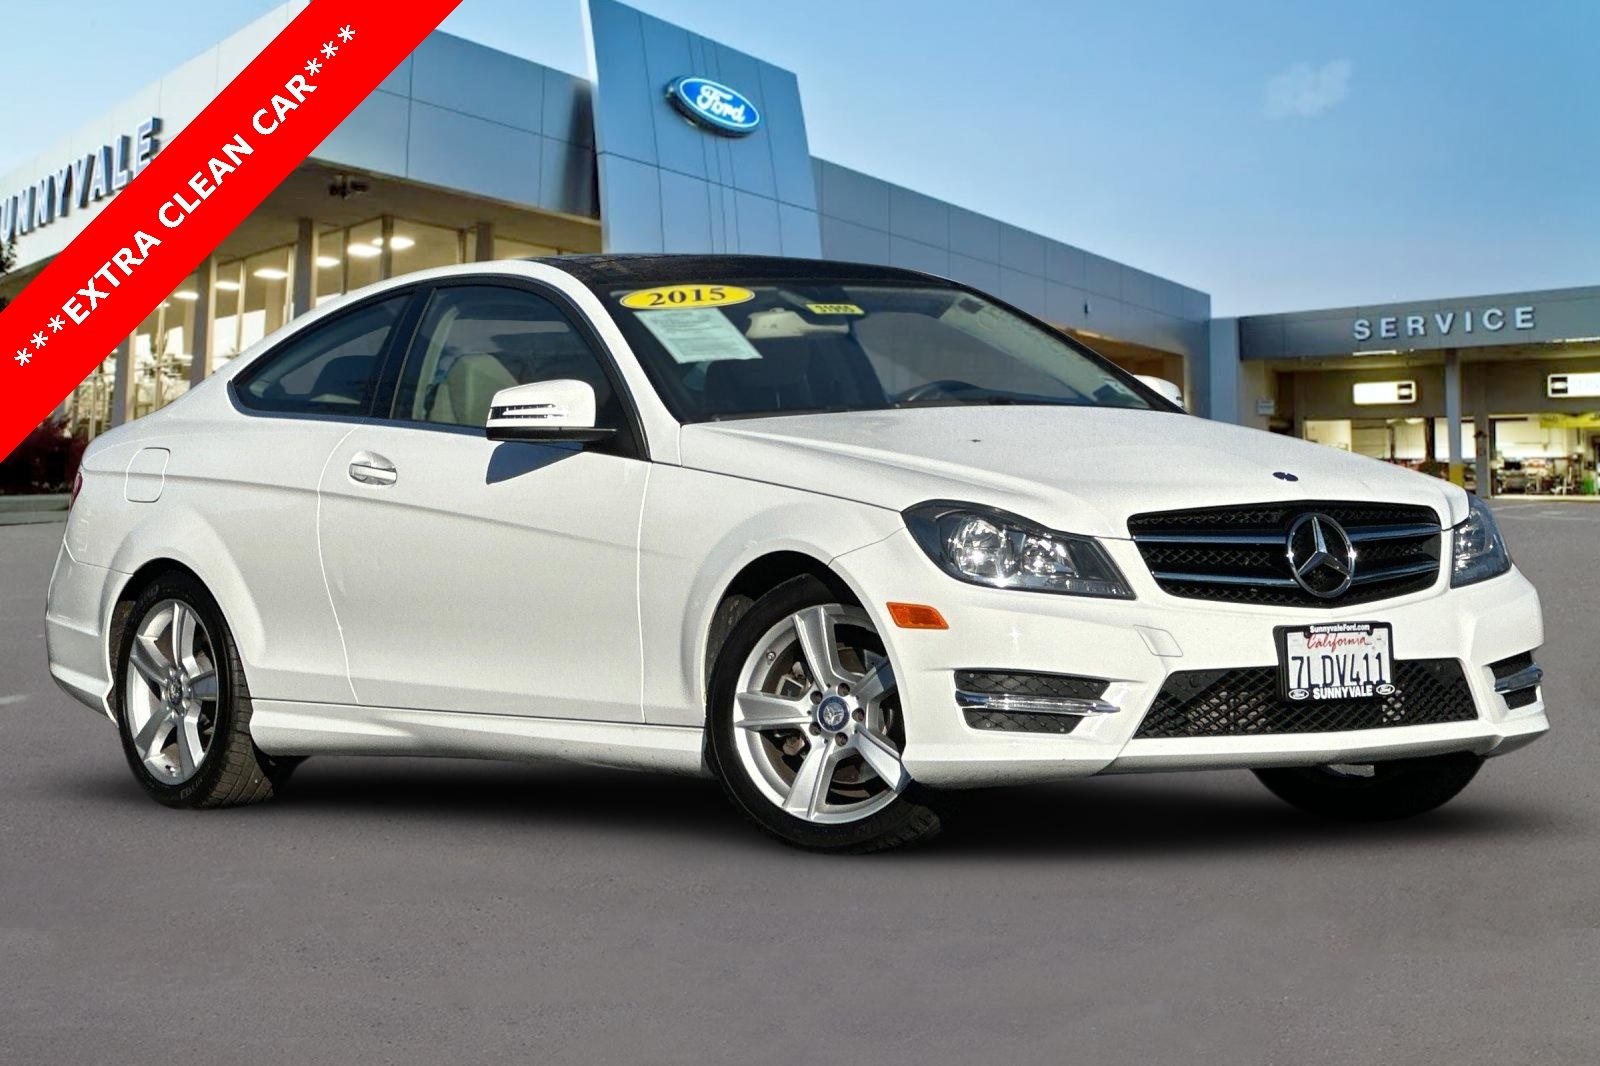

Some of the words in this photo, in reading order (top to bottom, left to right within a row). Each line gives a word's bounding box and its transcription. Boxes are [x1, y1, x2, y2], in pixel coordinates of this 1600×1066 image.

[696, 85, 746, 122] Ford
[647, 287, 726, 306] 2015
[1354, 306, 1536, 341] SERVICE
[1306, 632, 1372, 653] California
[1291, 652, 1387, 689] 7LDV411
[1312, 684, 1374, 700] SUNNYVALE
